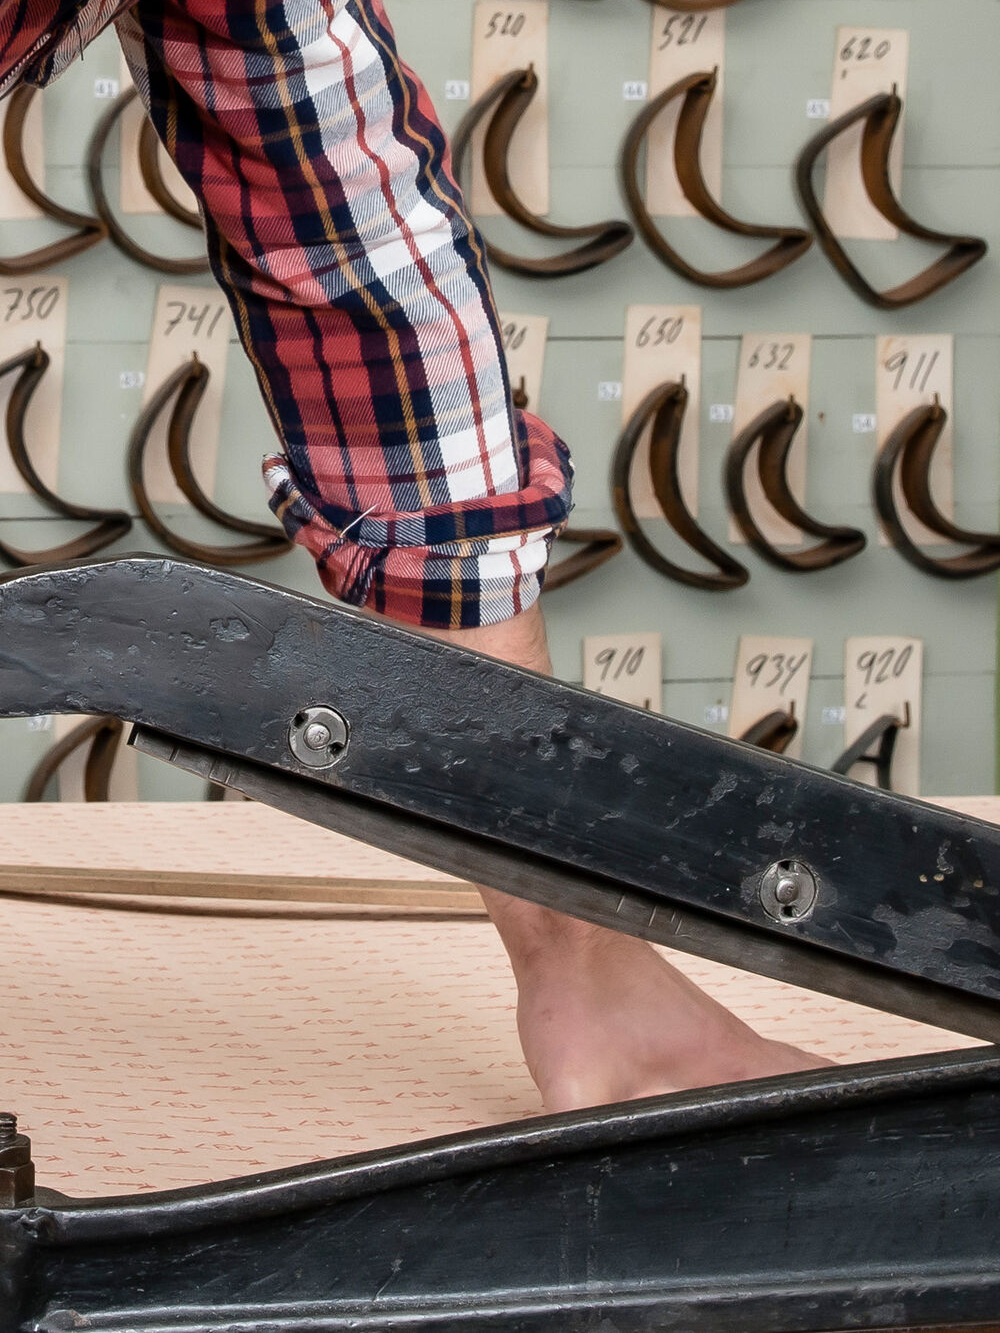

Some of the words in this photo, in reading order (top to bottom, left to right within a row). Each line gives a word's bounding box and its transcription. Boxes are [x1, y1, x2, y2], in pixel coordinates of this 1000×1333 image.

[658, 12, 709, 52] 521
[839, 36, 892, 62] 620
[3, 285, 60, 322] 750
[163, 301, 225, 338] 741
[635, 315, 685, 348] 650
[747, 342, 796, 371] 632
[884, 351, 941, 394] 911
[593, 647, 645, 683] 910
[745, 653, 808, 697] 934
[855, 643, 914, 685] 920
[151, 1100, 207, 1108] 437
[43, 1120, 102, 1128] 437
[195, 1143, 253, 1151] 437
